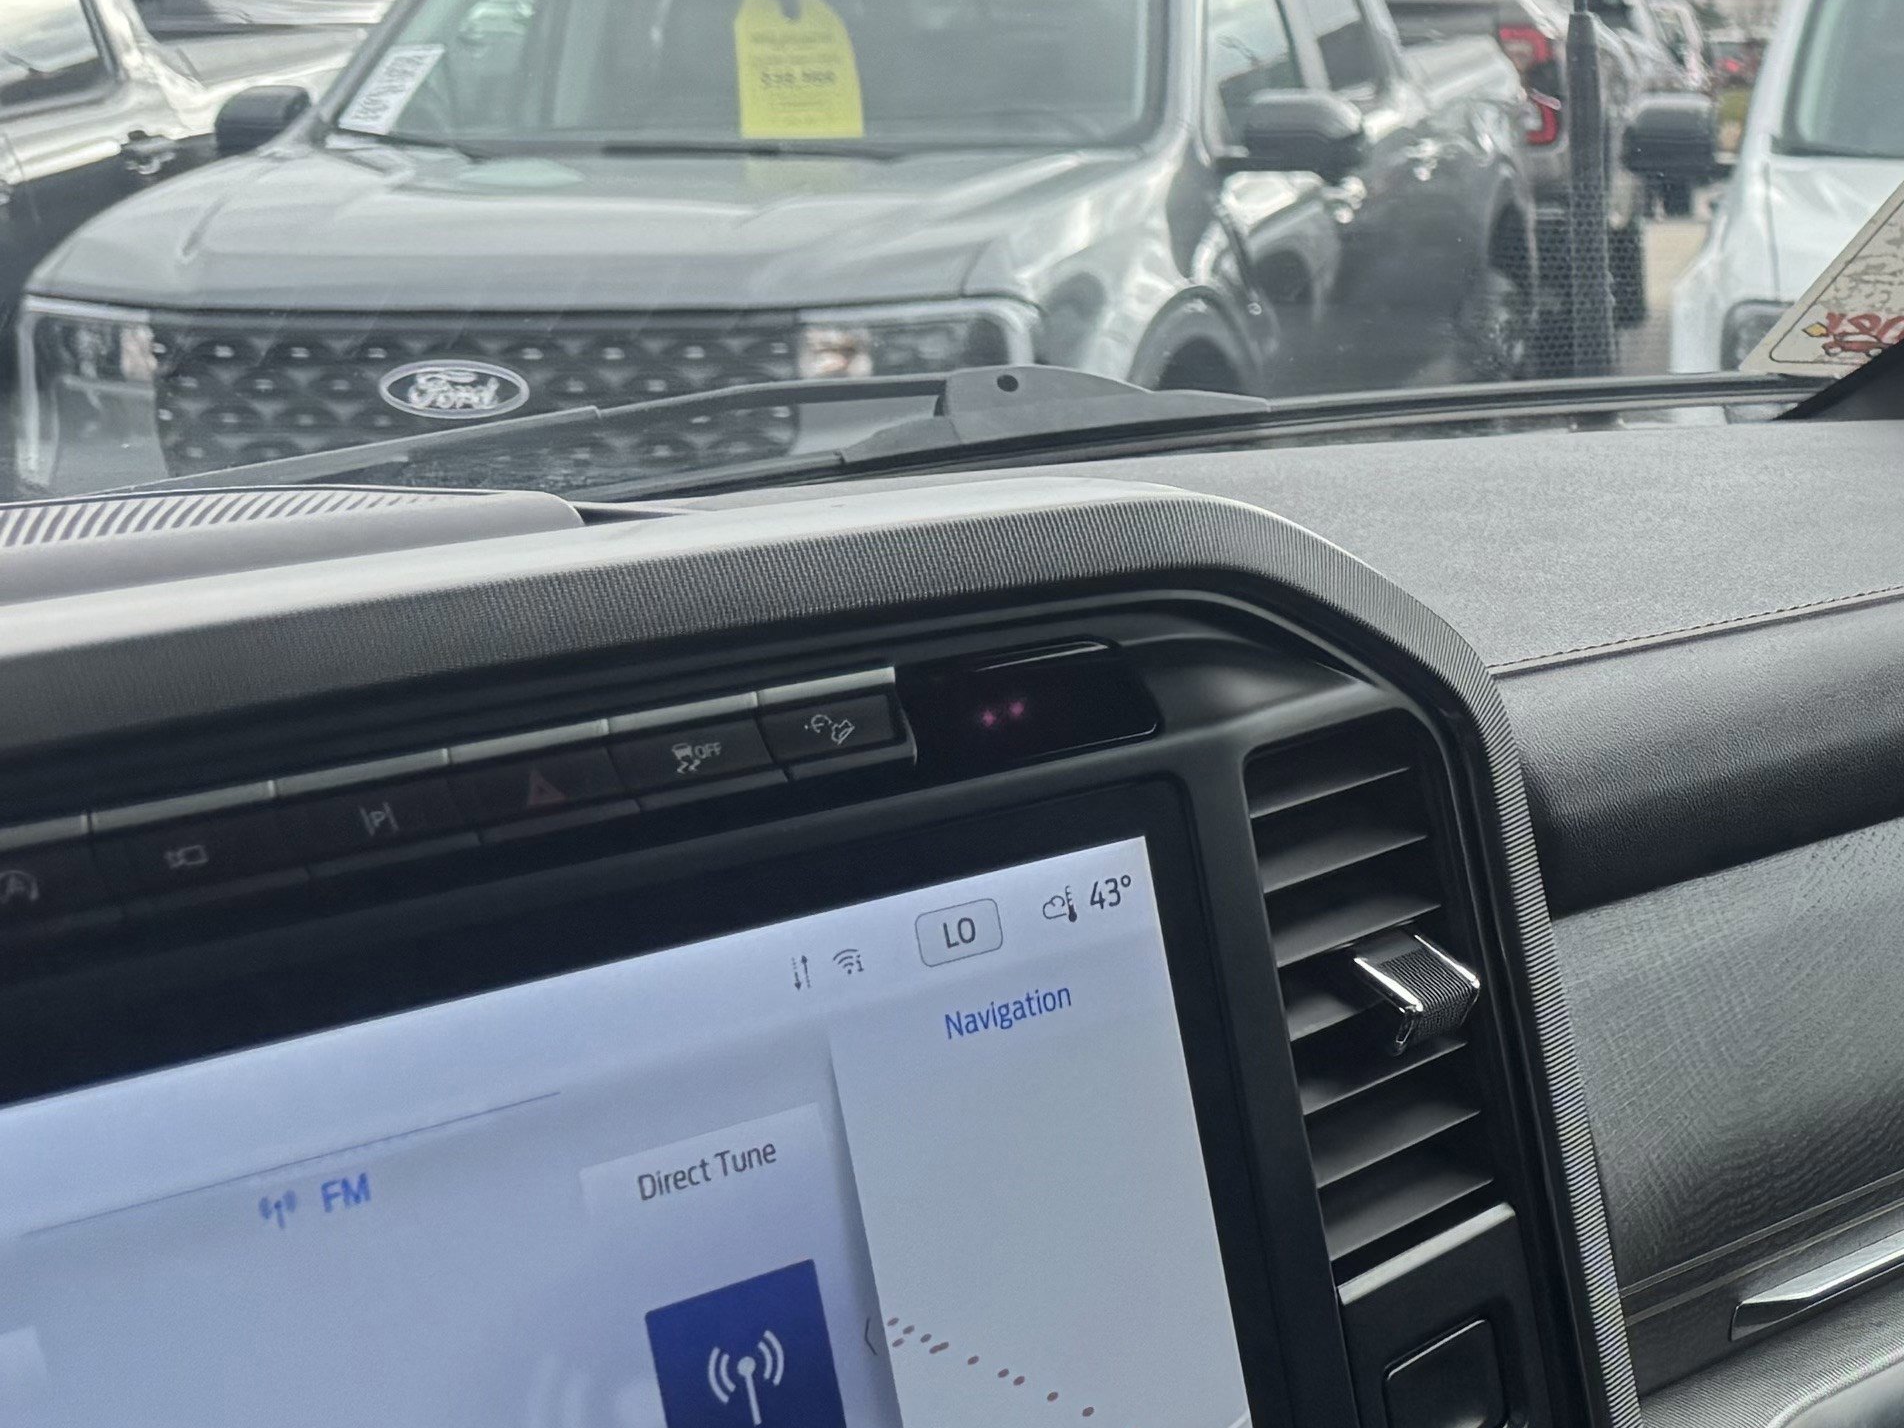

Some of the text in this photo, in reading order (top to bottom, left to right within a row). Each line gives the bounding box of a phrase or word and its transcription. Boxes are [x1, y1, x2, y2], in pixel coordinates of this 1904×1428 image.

[408, 371, 499, 410] Ford
[695, 741, 723, 760] OFF
[1090, 876, 1131, 909] 43°
[944, 918, 975, 948] LO
[946, 986, 1071, 1039] Navigation
[639, 1142, 776, 1201] Direct Tune
[323, 1175, 370, 1209] FM
